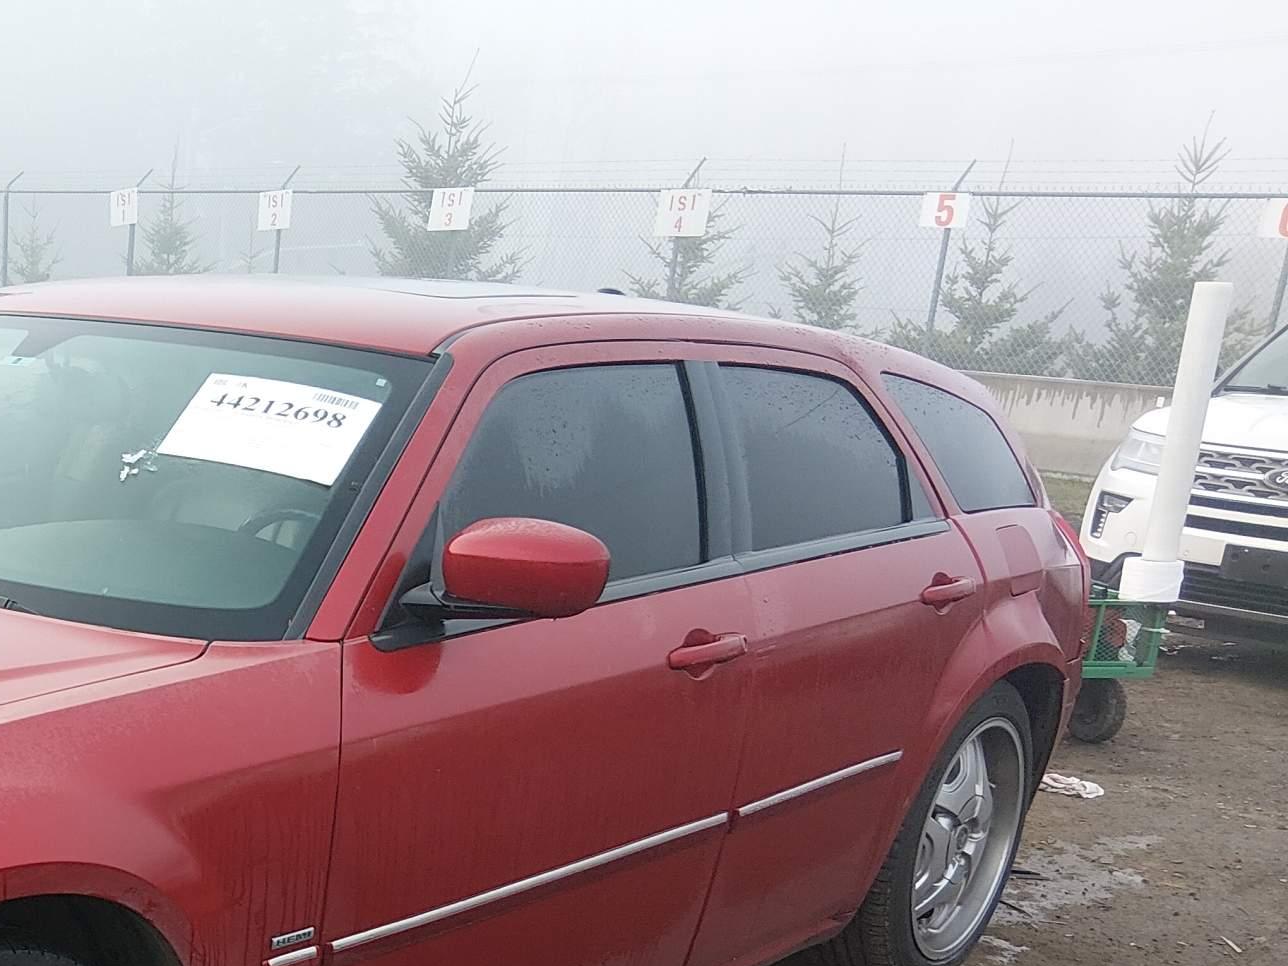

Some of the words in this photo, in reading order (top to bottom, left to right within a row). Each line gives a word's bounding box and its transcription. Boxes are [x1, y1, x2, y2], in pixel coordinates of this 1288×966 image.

[934, 194, 957, 227] 5
[270, 212, 277, 226] 2
[444, 212, 454, 226] 3
[674, 215, 683, 232] 4
[210, 393, 347, 428] 44212698
[276, 931, 312, 946] HEMI
